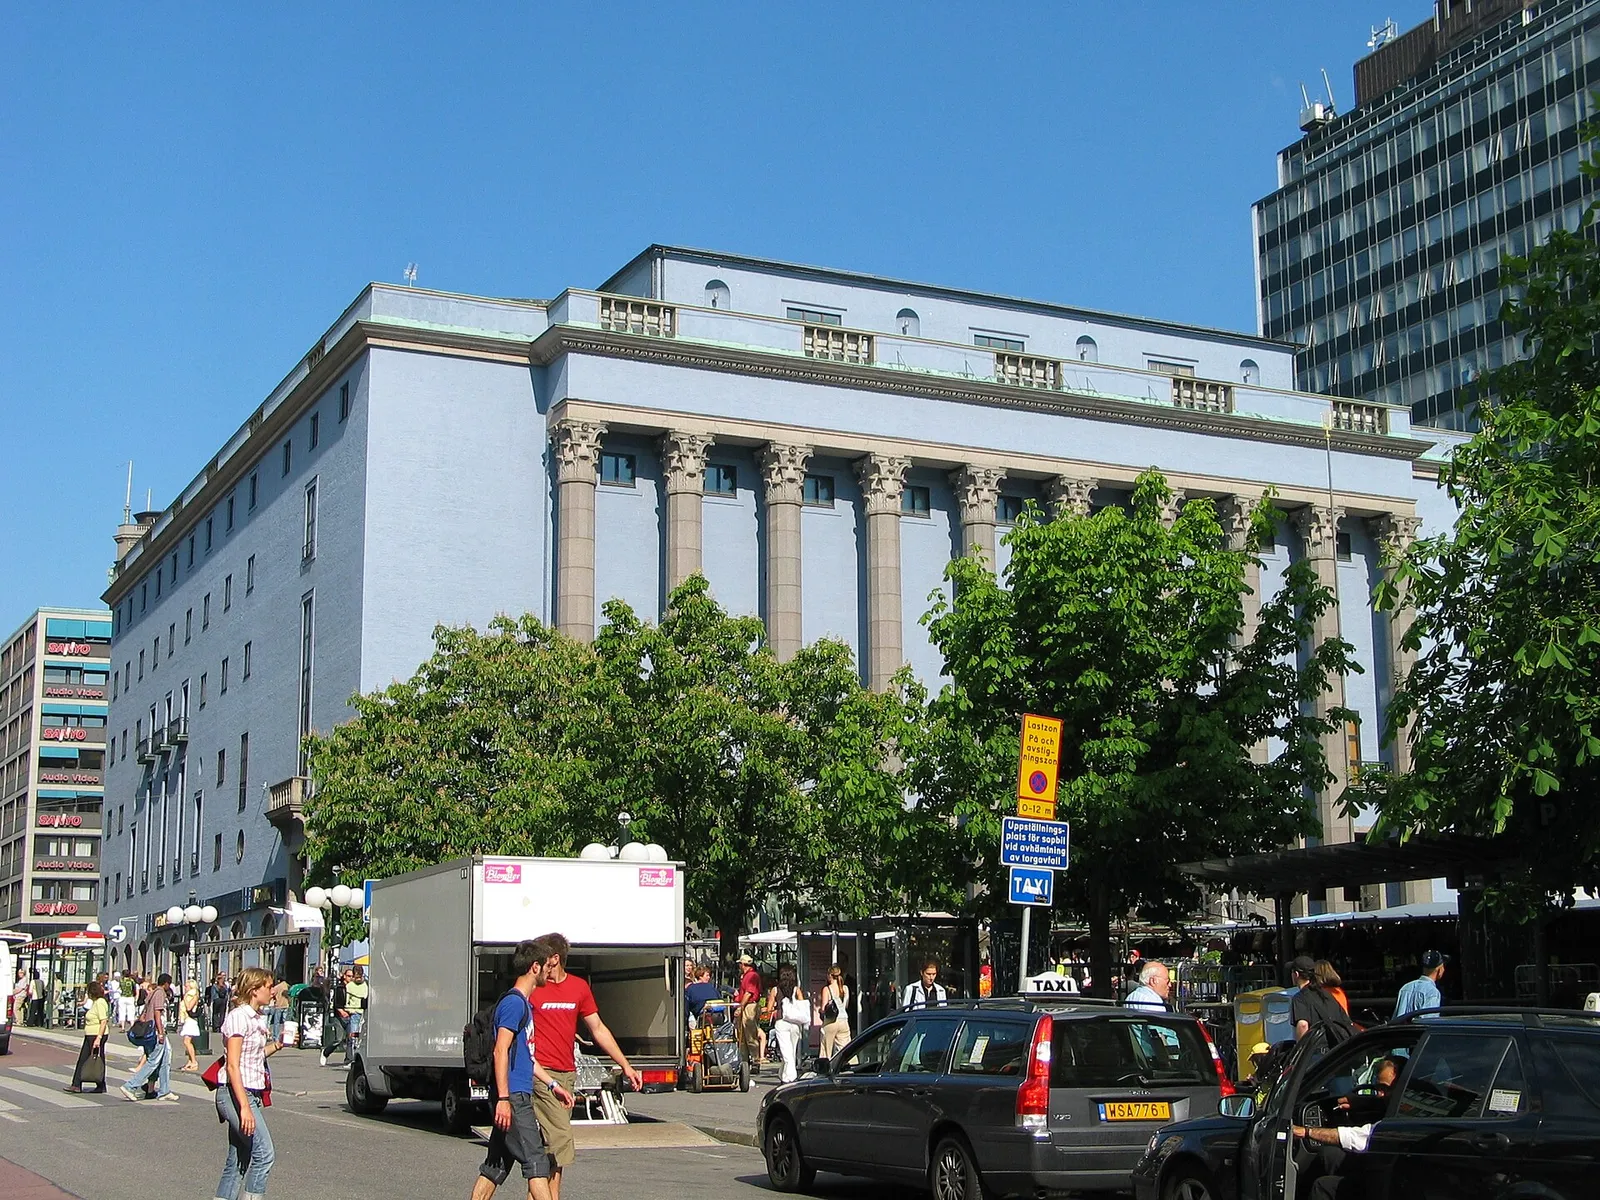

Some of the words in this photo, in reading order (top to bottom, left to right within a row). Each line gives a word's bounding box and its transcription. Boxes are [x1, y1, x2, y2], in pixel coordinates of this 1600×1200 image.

[48, 642, 91, 655] SANYO
[46, 687, 73, 696] Audio
[76, 688, 104, 697] Video
[1027, 720, 1058, 733] Lastzon
[44, 727, 87, 740] SANYO
[1029, 734, 1039, 743] På
[1026, 745, 1055, 757] avstig-
[1022, 753, 1058, 765] ningszon
[41, 773, 69, 782] Audio
[72, 774, 99, 783] Video
[1022, 803, 1041, 814] 0-12
[39, 813, 82, 828] SANYO
[1008, 820, 1065, 836] Uppställnings-
[1006, 831, 1026, 841] plats
[1028, 833, 1040, 843] för
[1041, 836, 1066, 846] sopbil
[1005, 842, 1018, 850] vid
[1020, 844, 1065, 857] avhämtning
[36, 860, 64, 869] Audio
[67, 861, 95, 870] Video
[1010, 854, 1020, 862] av
[1022, 854, 1061, 865] torgavfall
[1013, 876, 1049, 896] TAXI
[34, 902, 77, 916] SANYO
[1032, 979, 1072, 992] TAXI
